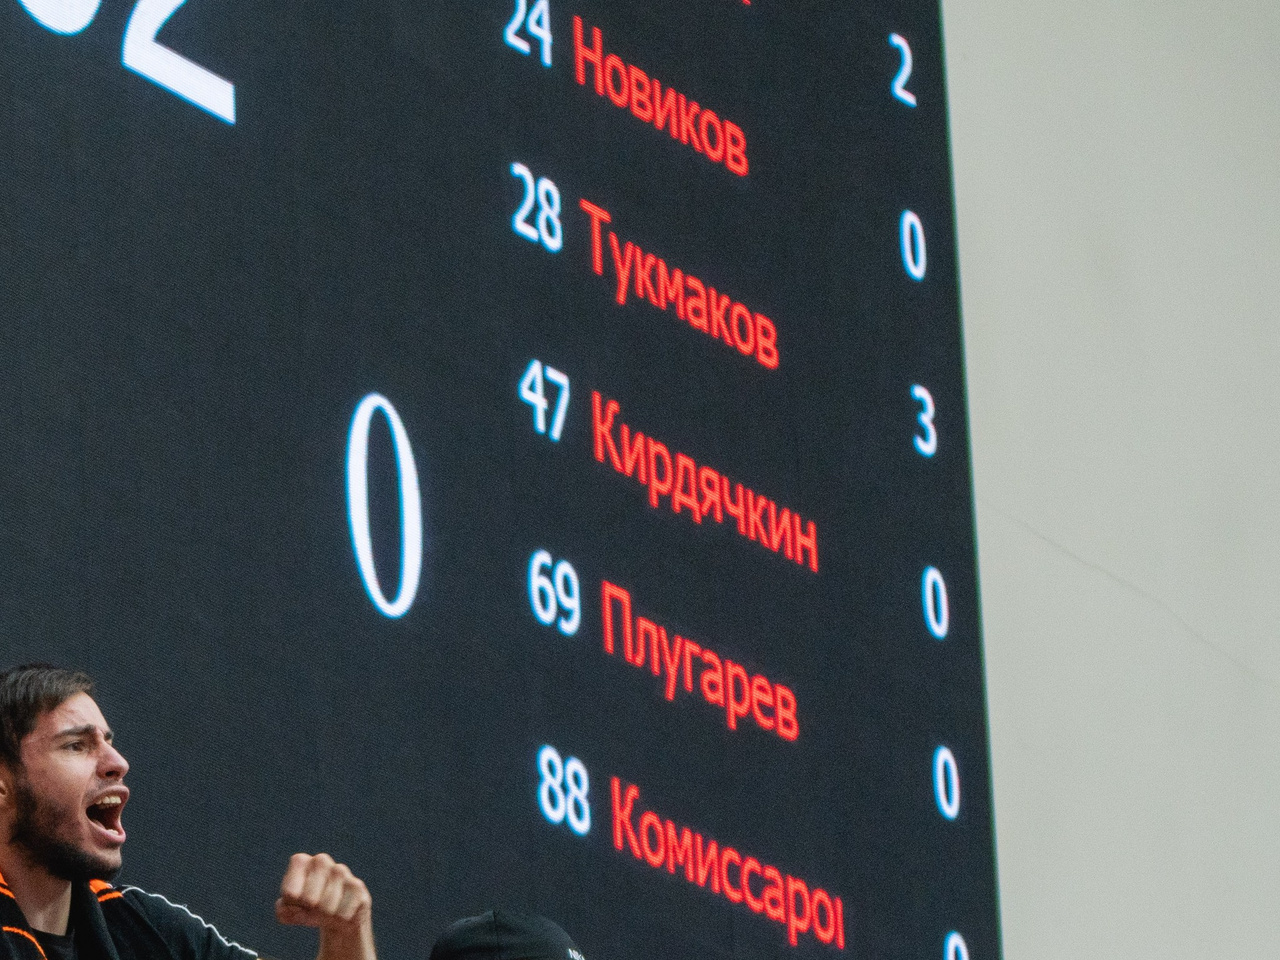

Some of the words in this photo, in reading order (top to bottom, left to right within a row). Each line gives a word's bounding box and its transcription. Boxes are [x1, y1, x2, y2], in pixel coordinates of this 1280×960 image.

[503, 0, 553, 67] 24
[574, 15, 749, 177] Новиков
[900, 210, 927, 281] 0
[889, 33, 918, 108] 2
[510, 162, 564, 253] 28
[580, 198, 780, 370] Тукмаков
[911, 384, 938, 457] 3
[345, 392, 423, 619] 0
[518, 358, 571, 442] 47
[592, 390, 819, 573] Кирдячкин
[922, 565, 950, 640] 0
[527, 549, 582, 637] 69
[601, 580, 800, 742] Плугарев
[933, 745, 961, 820] 0
[537, 744, 592, 837] 88
